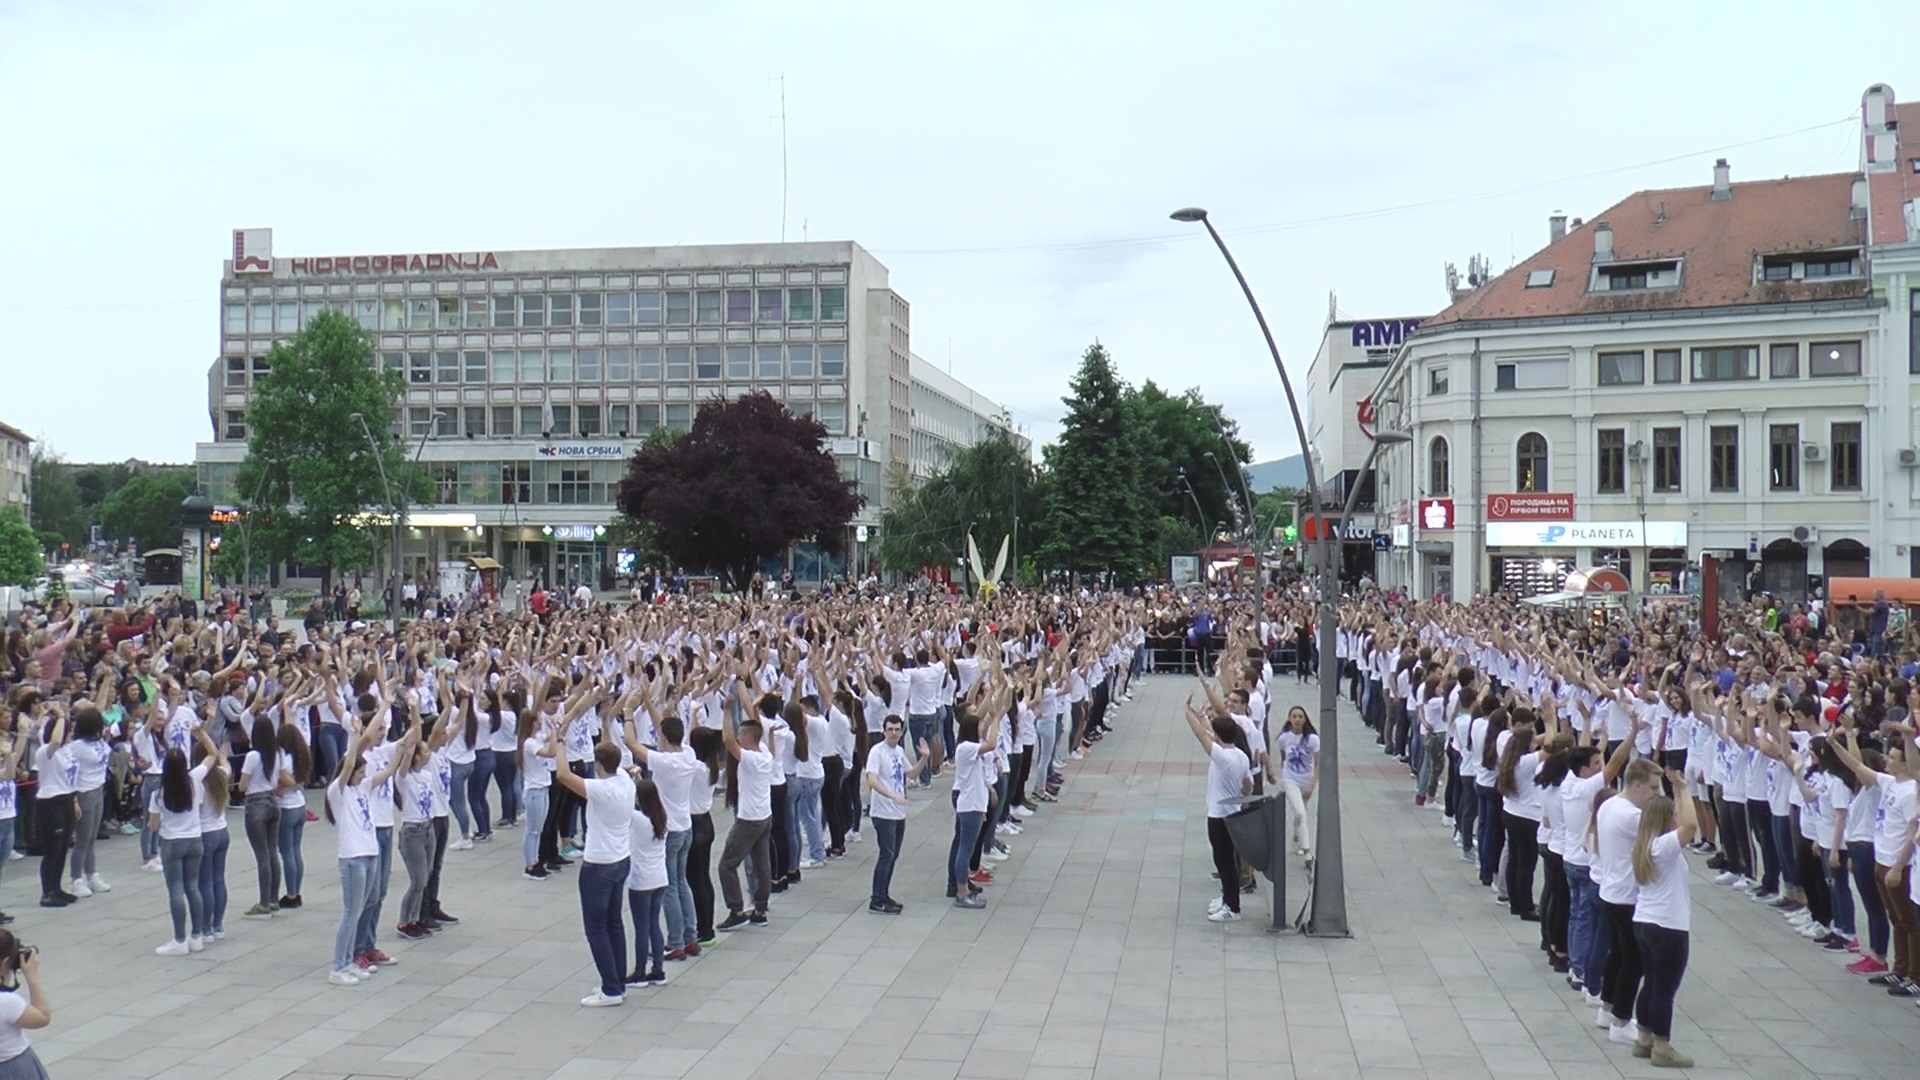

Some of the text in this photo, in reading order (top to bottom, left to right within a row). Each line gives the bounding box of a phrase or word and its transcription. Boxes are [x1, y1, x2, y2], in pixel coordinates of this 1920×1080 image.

[291, 252, 499, 274] HIDROGRADNJA
[558, 446, 585, 455] НОВА
[586, 446, 622, 455] СРБИЈА
[1510, 498, 1569, 507] ПОРОДИЦА НА
[1510, 506, 1569, 514] ПРВОМ МЕСТУ!
[1571, 528, 1635, 540] PLANETA
